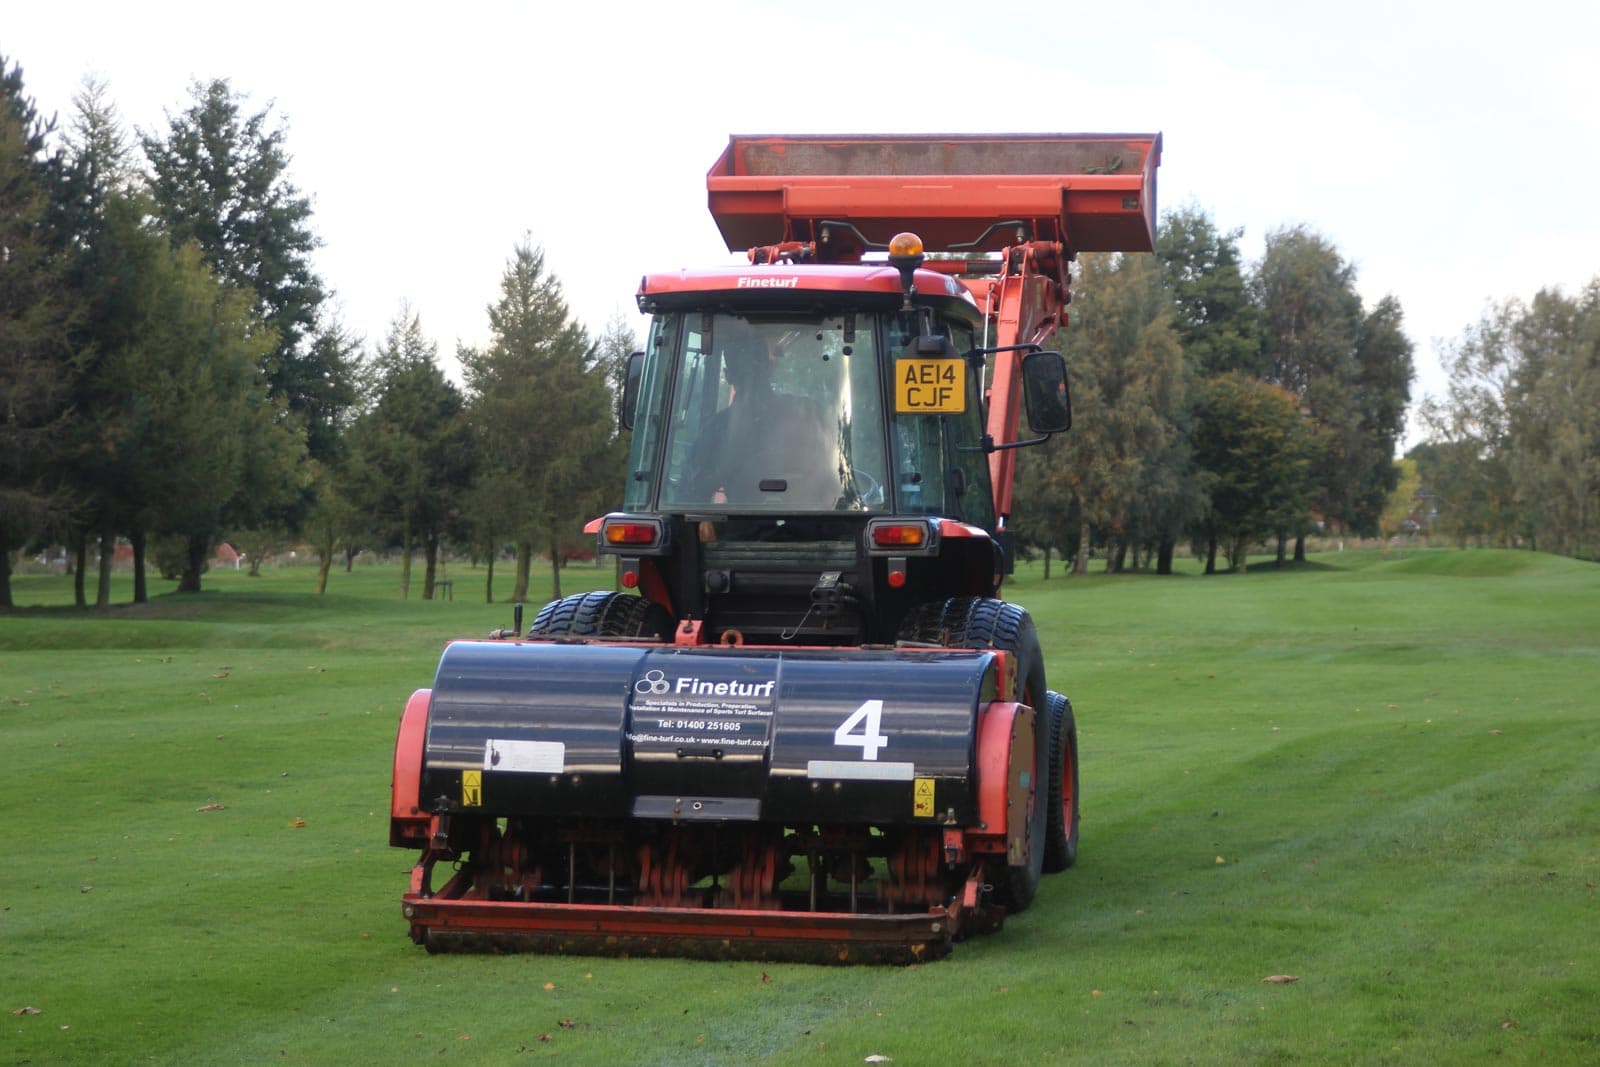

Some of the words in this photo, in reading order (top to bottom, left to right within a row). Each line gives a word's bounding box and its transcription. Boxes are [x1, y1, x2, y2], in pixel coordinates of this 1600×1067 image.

[738, 277, 798, 288] Fineturf
[905, 364, 956, 384] AE14
[907, 387, 953, 407] CJF
[675, 677, 776, 697] Fineturf
[667, 706, 705, 714] Maintenance
[713, 708, 733, 716] Sports
[658, 719, 675, 728] Tel:
[677, 720, 705, 730] 01400
[707, 721, 741, 731] 251605
[833, 699, 889, 761] 4
[701, 737, 770, 747] www.fine-turf.co.u
